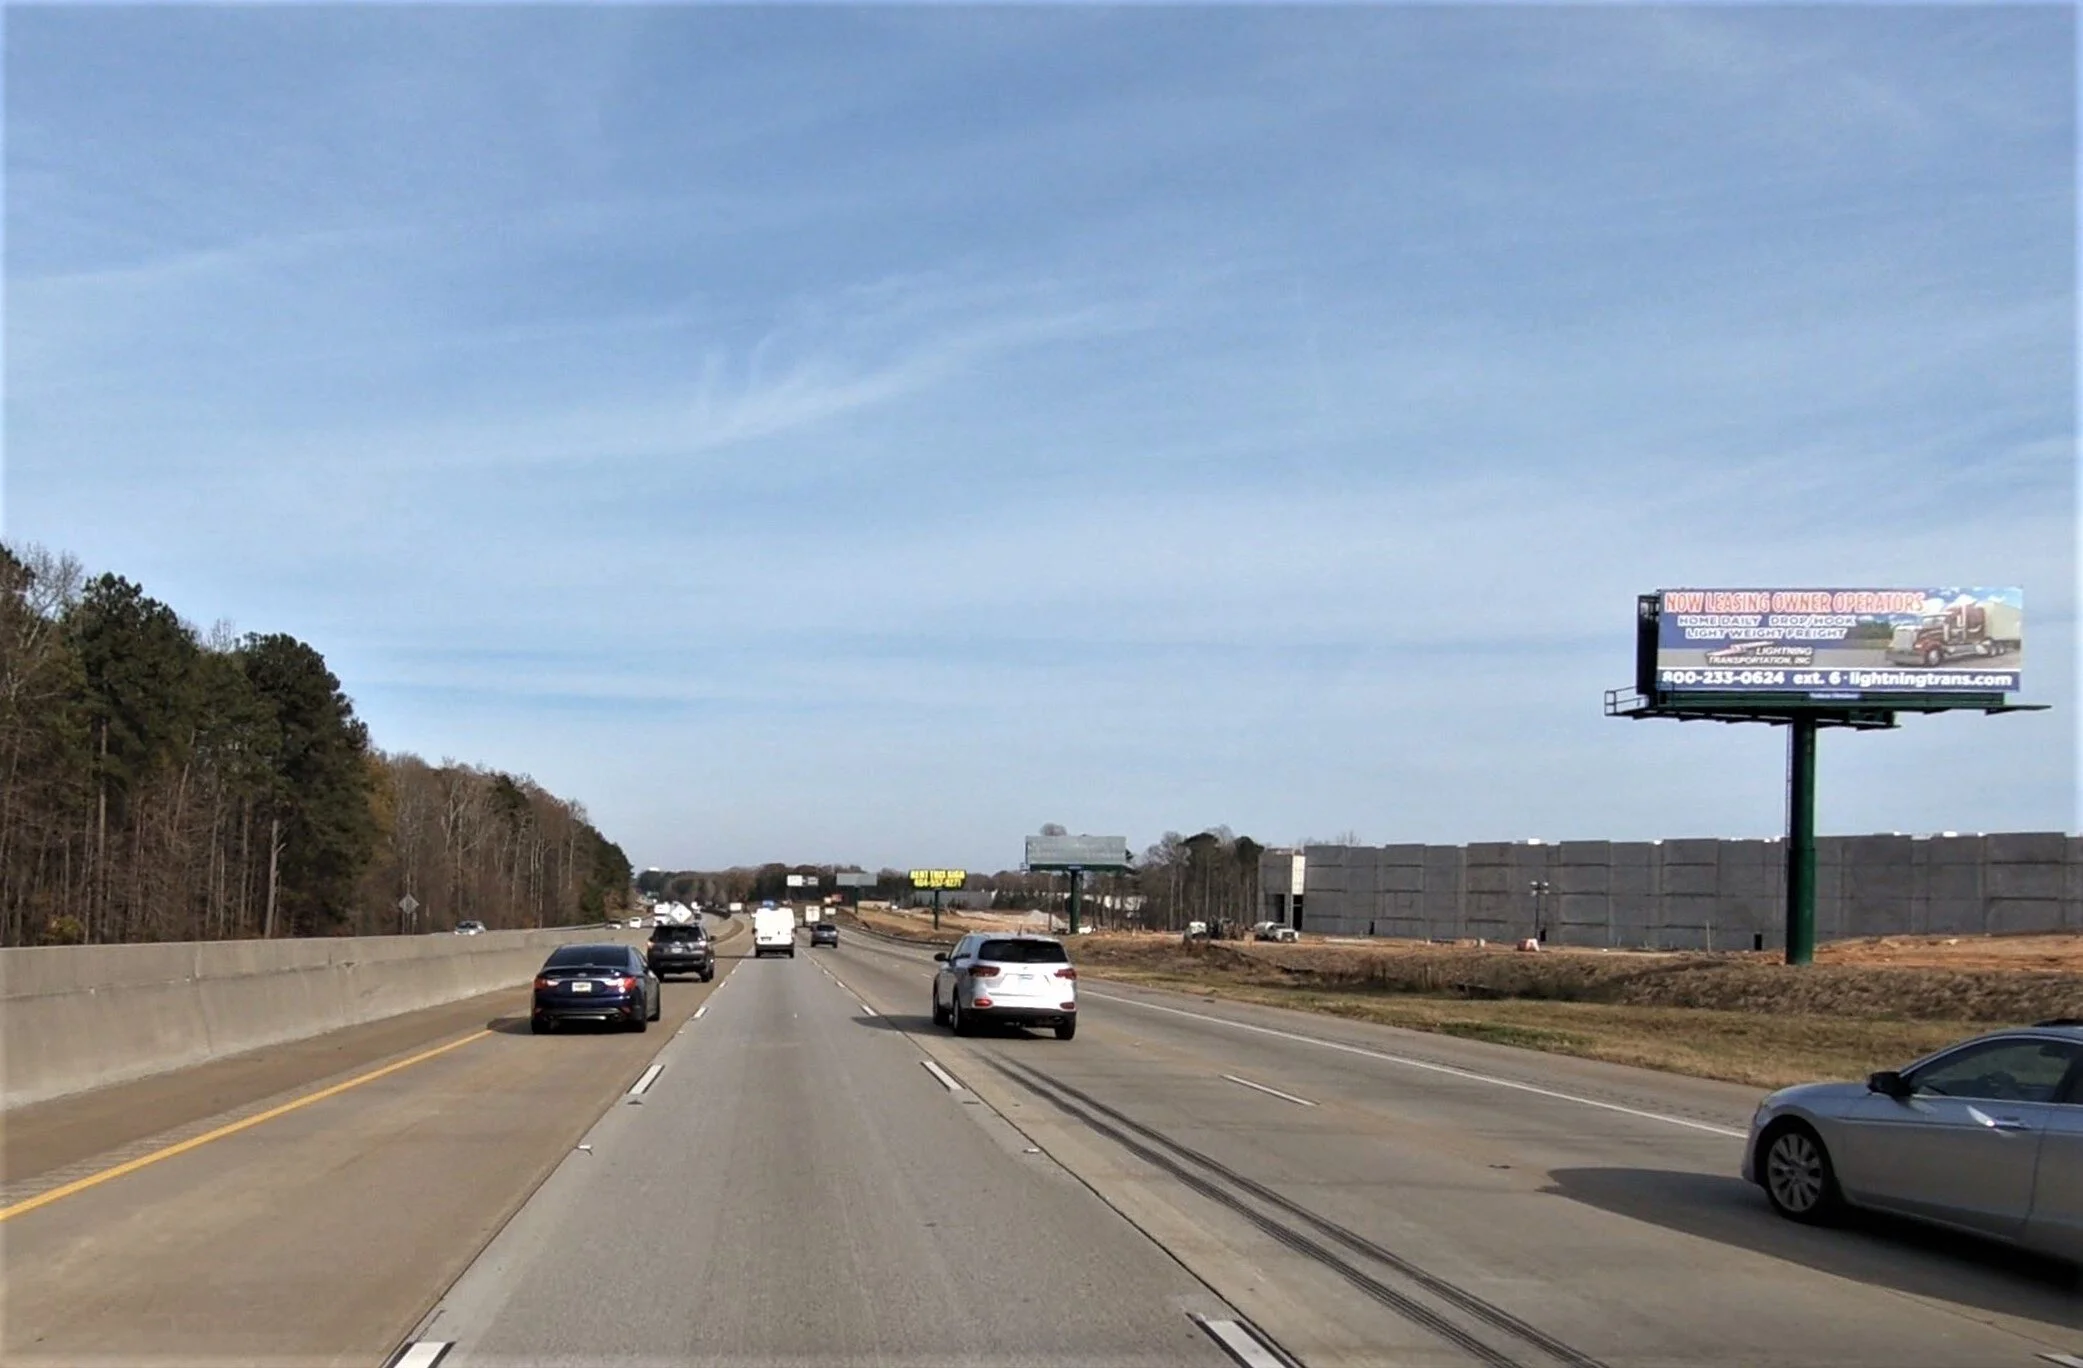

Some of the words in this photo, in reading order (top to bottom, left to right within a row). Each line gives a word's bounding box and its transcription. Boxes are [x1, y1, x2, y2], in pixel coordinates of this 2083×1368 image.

[1664, 591, 1703, 613] NOW
[1704, 591, 1769, 613] LEASING
[1771, 591, 1832, 613] OWNER
[1833, 591, 1925, 613] OPERATORS
[1768, 615, 1857, 628] DROP/HOOK
[1785, 628, 1848, 639] FREIGHT
[1756, 646, 1812, 656] LIGHTNING
[1662, 671, 1785, 684] 800-233-0624
[1793, 672, 1825, 684] ext.
[1829, 672, 1841, 685] 6
[1849, 671, 2012, 687] lightningtrans.com
